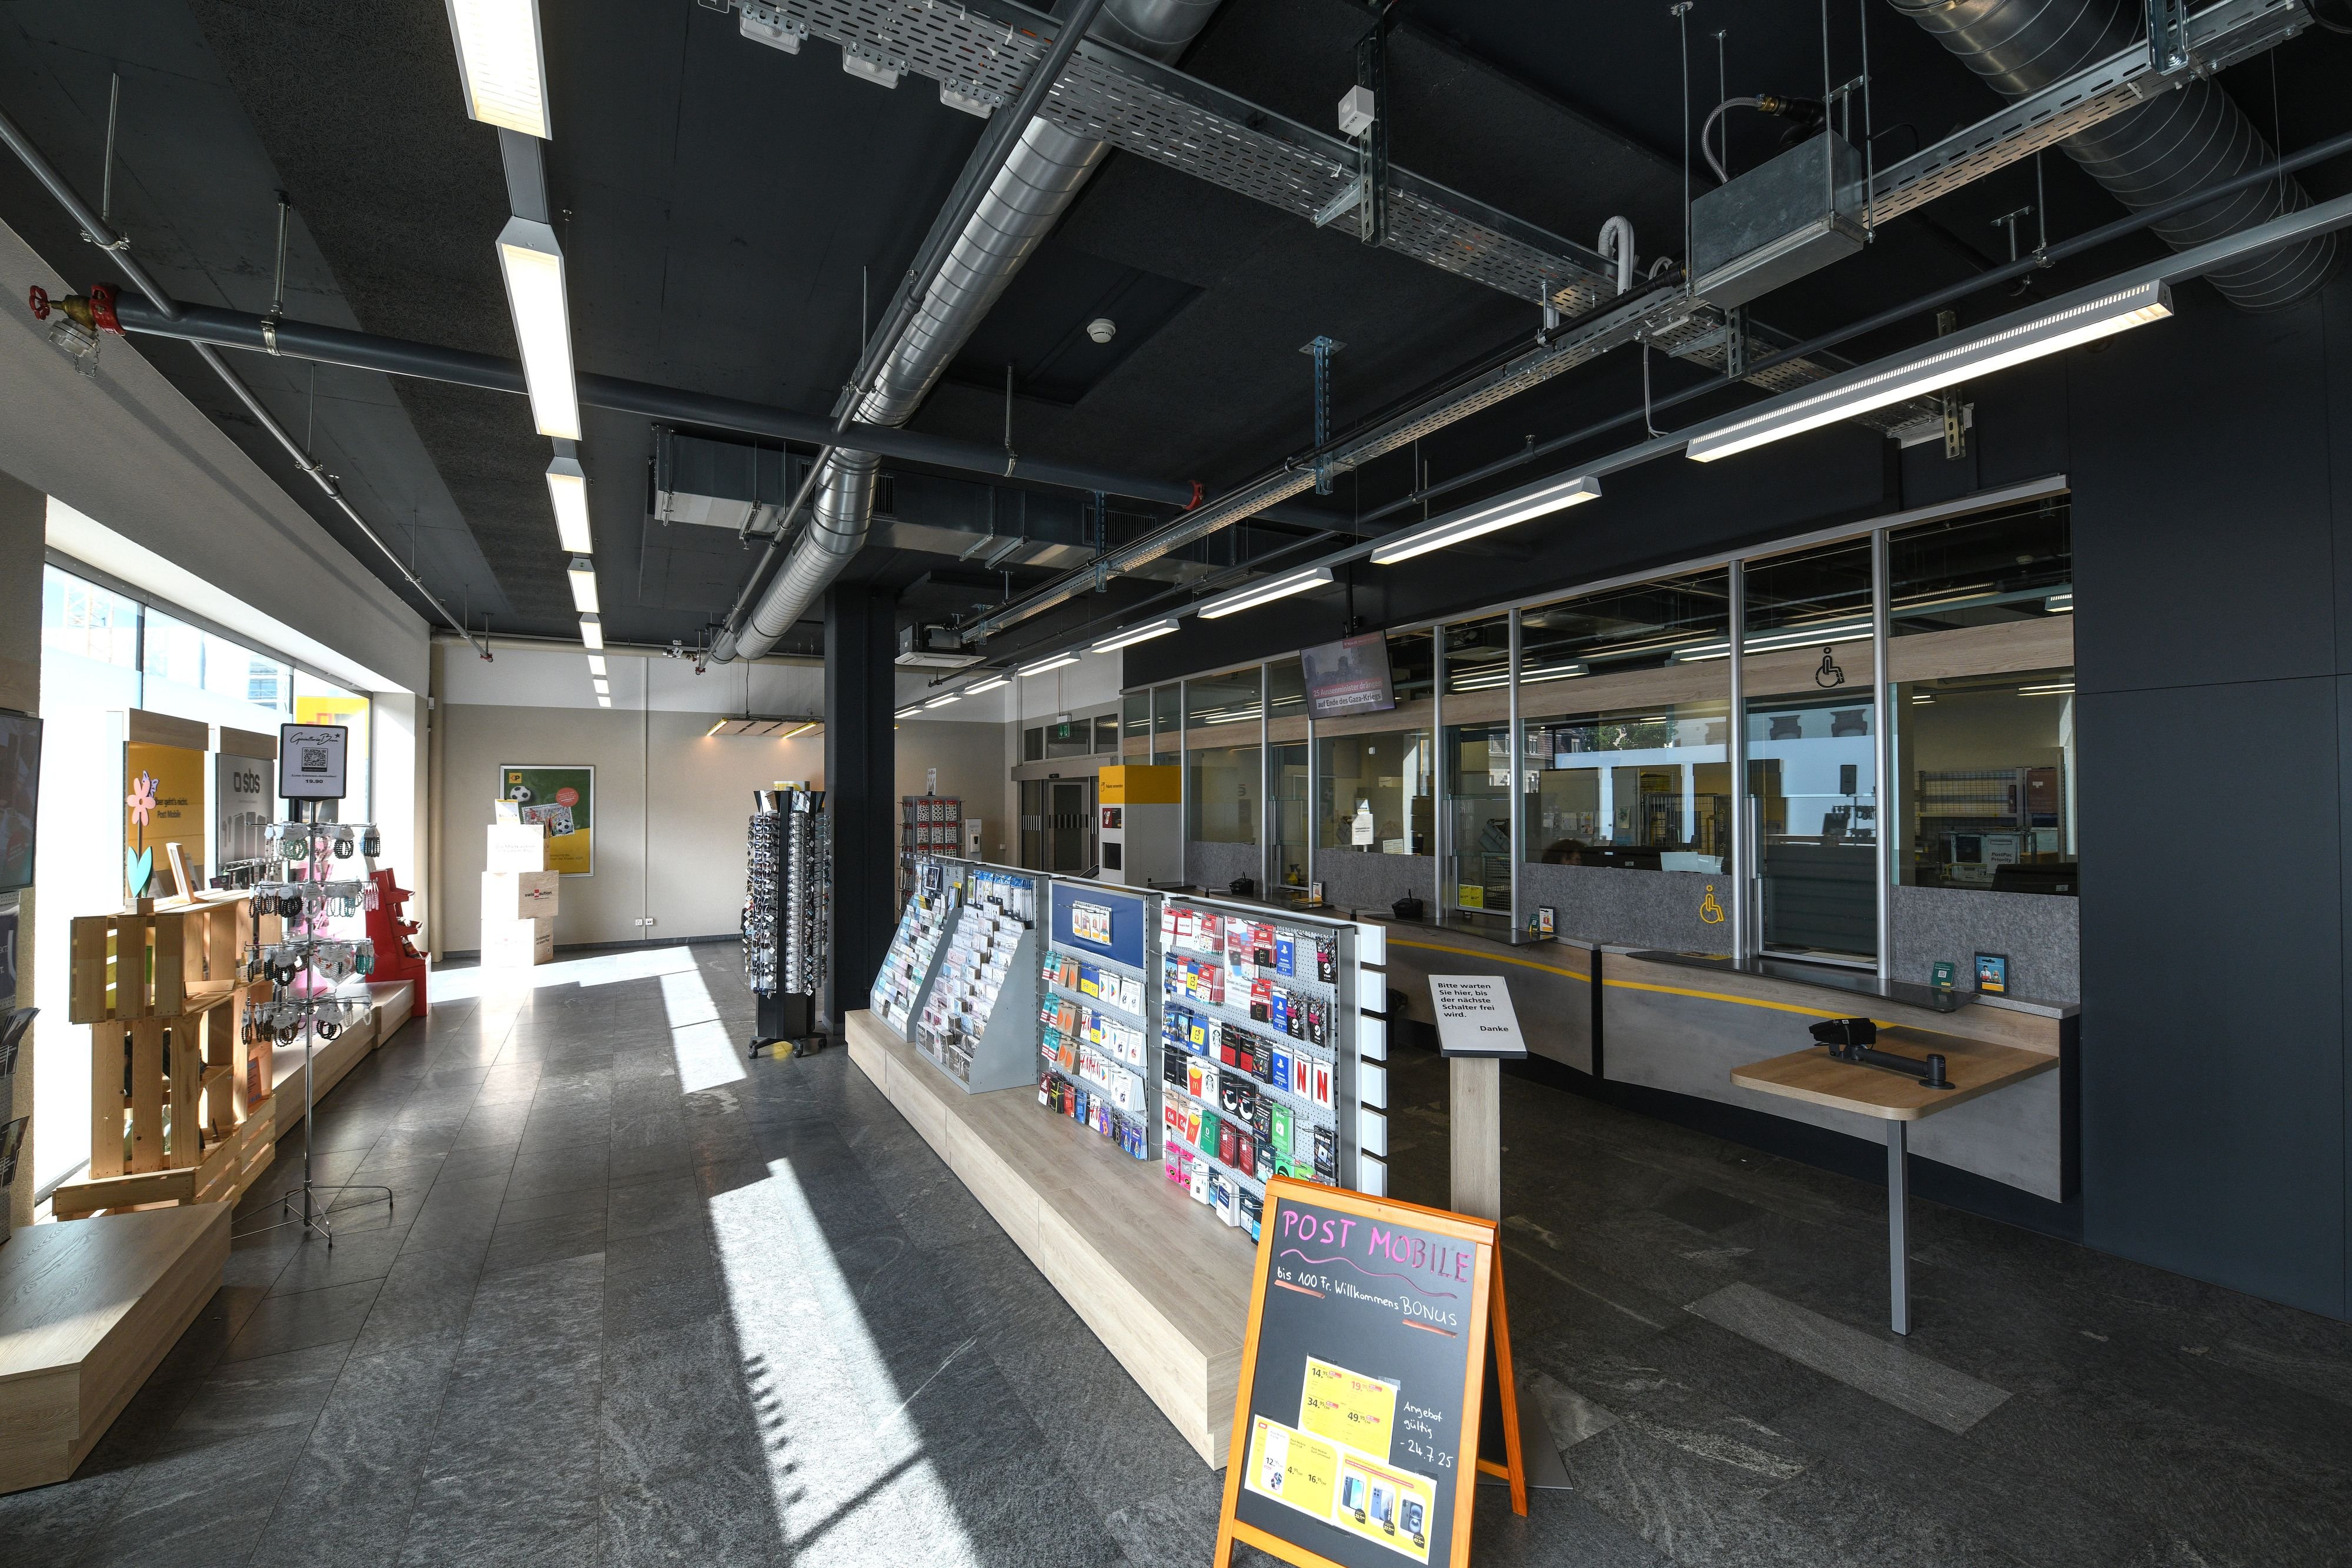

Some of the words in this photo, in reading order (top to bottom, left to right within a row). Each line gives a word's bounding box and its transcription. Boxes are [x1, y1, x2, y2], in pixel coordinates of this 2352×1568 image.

[1321, 684, 1359, 695] Aussenminister
[1359, 680, 1382, 690] drängen
[1348, 693, 1381, 703] Gaza-Kriegs
[243, 768, 260, 794] sbs
[1297, 1061, 1306, 1093] N
[1317, 1069, 1327, 1103] N
[1315, 1134, 1331, 1144] ROBLOX
[1282, 1210, 1357, 1248] POST
[1368, 1227, 1471, 1282] MOBILE
[1277, 1266, 1292, 1281] bis
[1298, 1272, 1317, 1288] 100
[1321, 1276, 1332, 1292] Fr.
[1335, 1282, 1399, 1310] Willkommens
[1400, 1296, 1457, 1326] BONUS
[1404, 1402, 1442, 1422] Angebot
[1404, 1419, 1432, 1439] gültig
